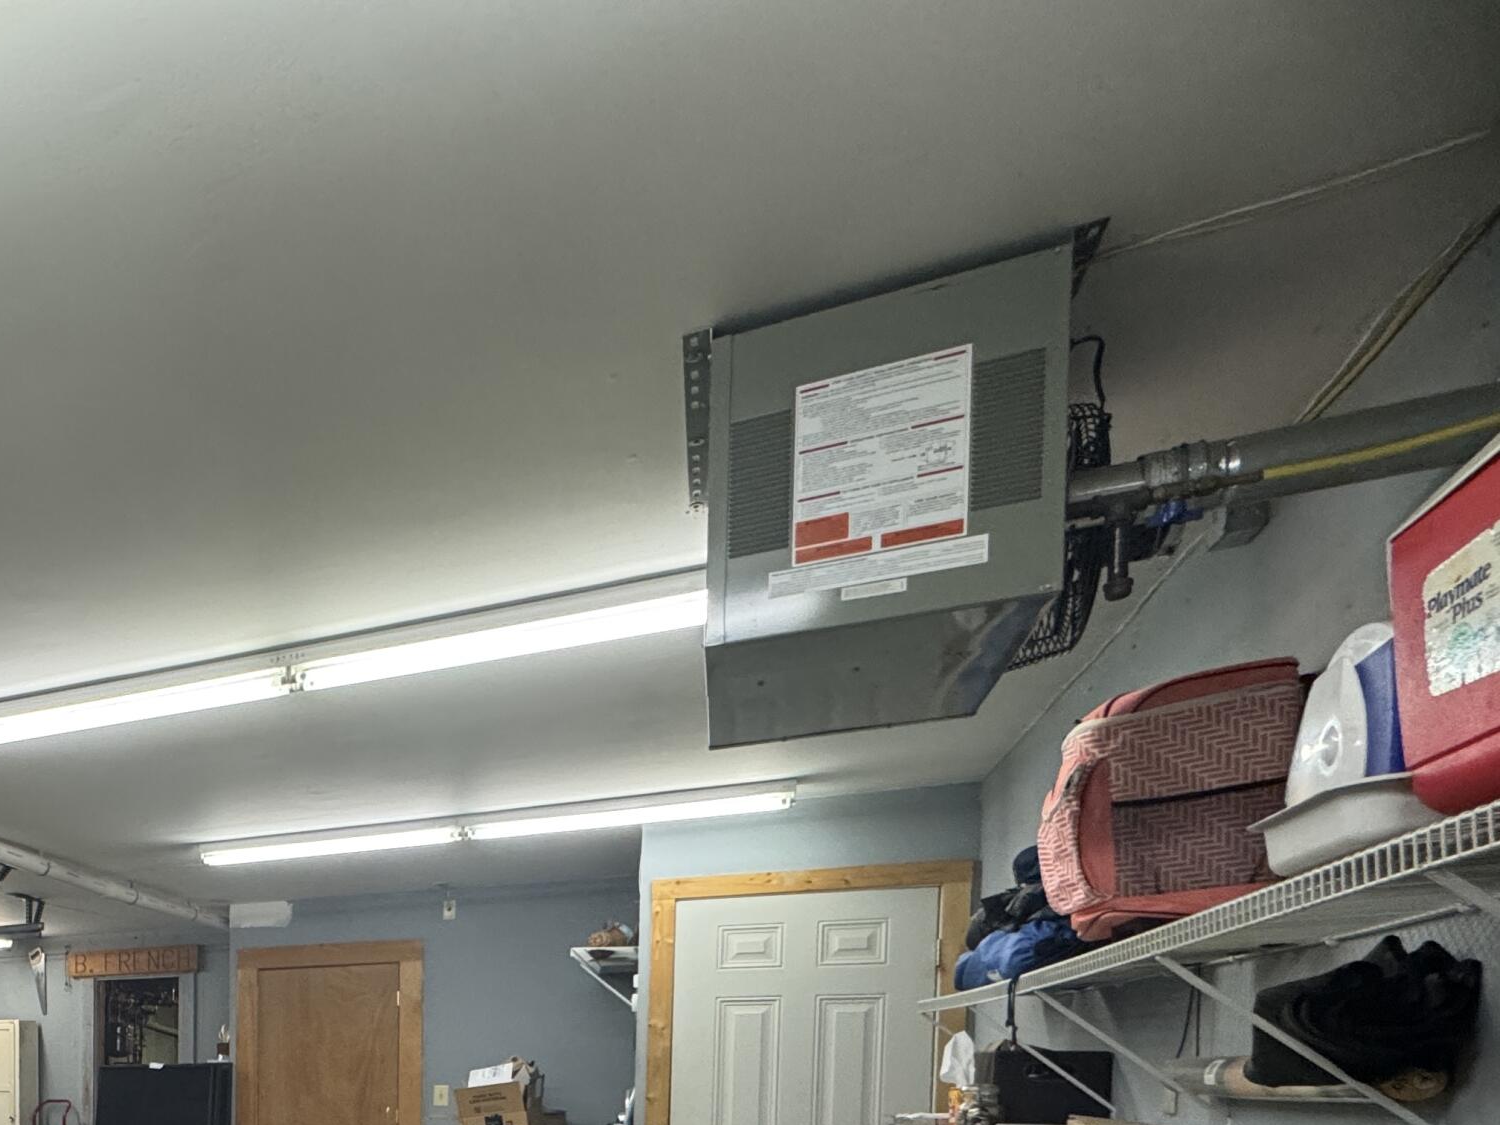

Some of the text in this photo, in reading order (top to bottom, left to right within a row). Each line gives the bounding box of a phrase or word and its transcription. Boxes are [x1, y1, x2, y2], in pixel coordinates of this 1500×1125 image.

[1428, 563, 1492, 618] Playmate
[1451, 591, 1484, 624] Plus
[74, 948, 191, 973] B. FRENCH
